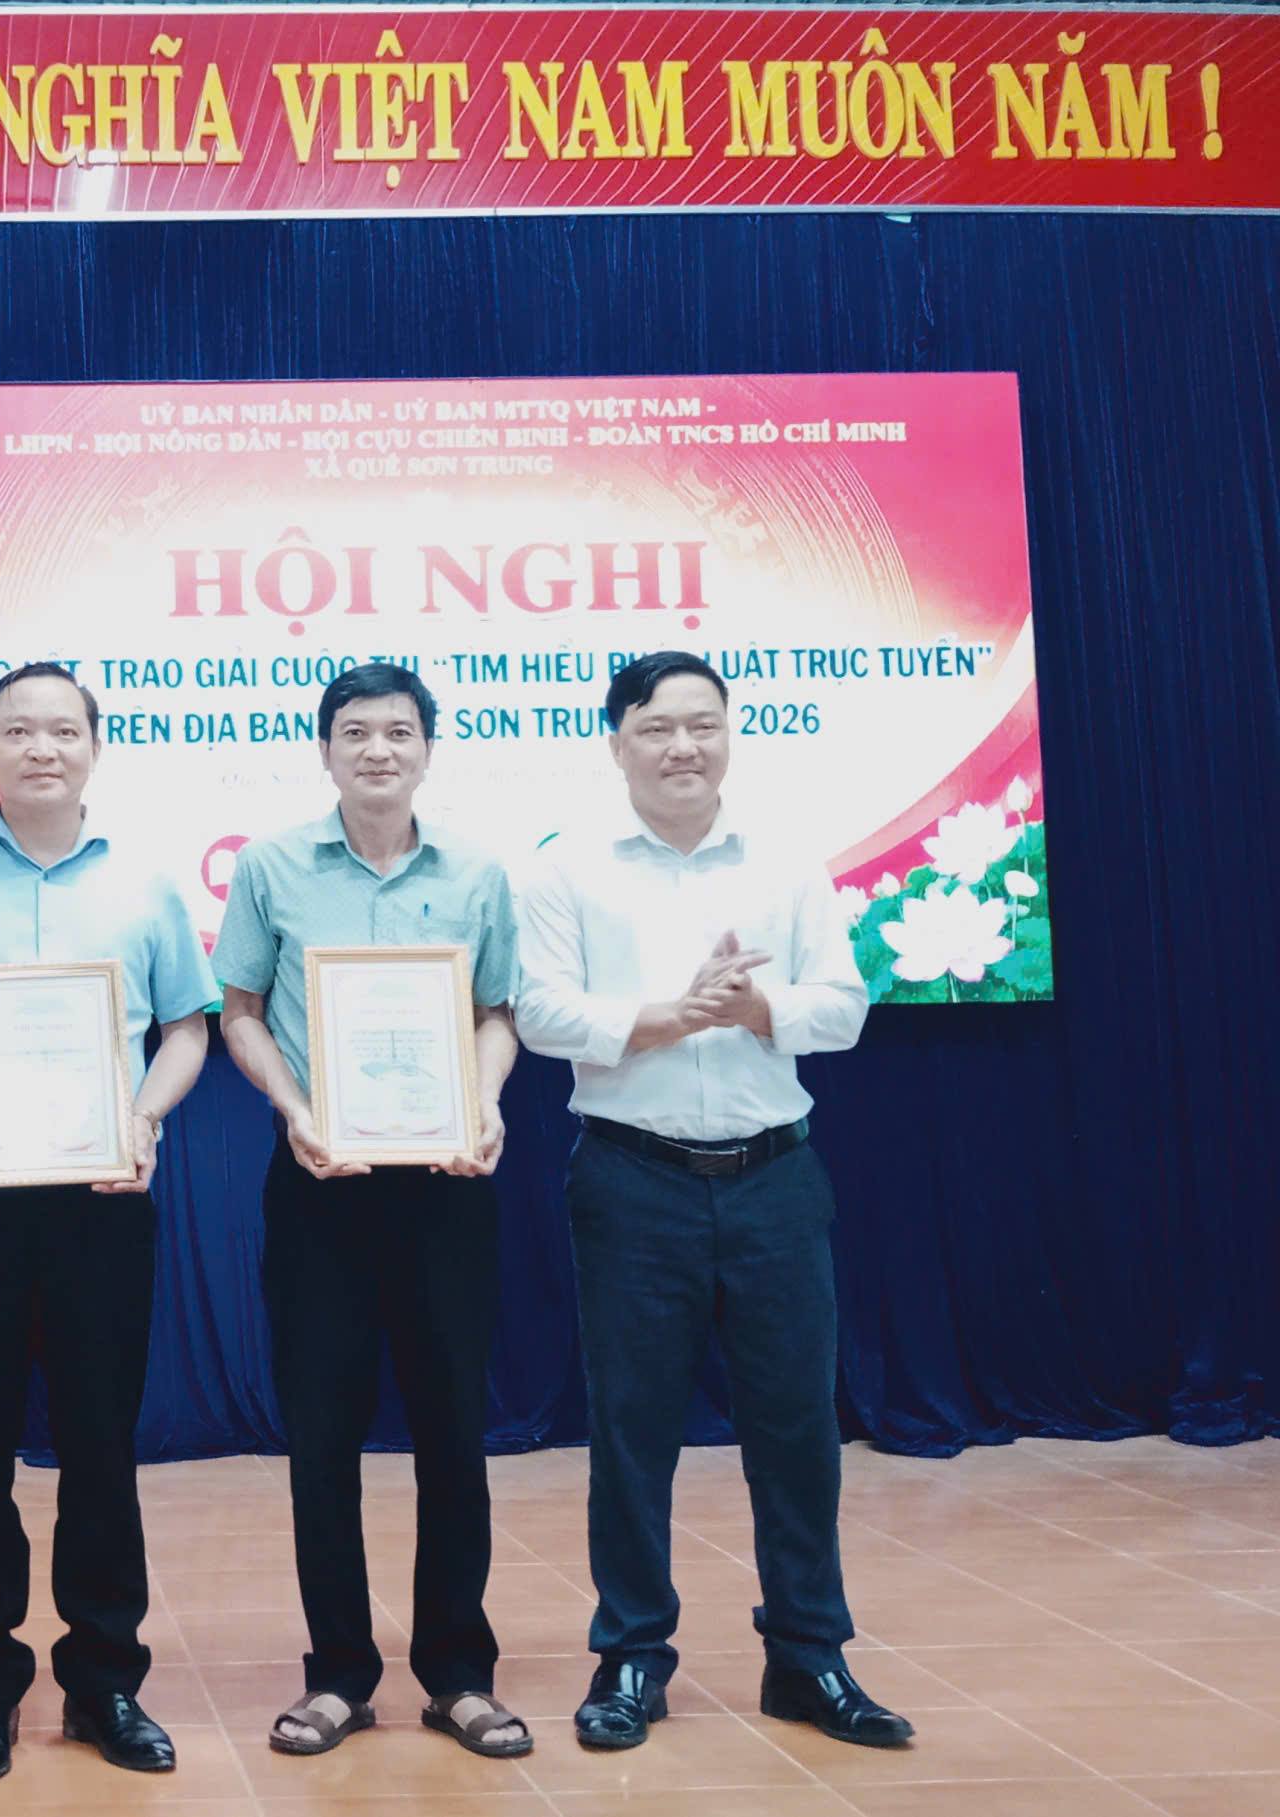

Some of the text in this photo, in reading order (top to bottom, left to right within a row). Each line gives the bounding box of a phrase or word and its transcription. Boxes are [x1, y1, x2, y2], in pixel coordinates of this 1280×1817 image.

[273, 30, 468, 189] VIỆT
[504, 60, 693, 160] NAM
[723, 28, 956, 159] MUÔN
[987, 31, 1176, 159] NĂM
[182, 403, 233, 425] BAN
[240, 398, 312, 424] NHÂN
[319, 398, 373, 423] DÂN
[435, 401, 486, 422] BAN
[494, 400, 569, 422] MTTQ
[574, 396, 637, 422] VIỆT
[641, 398, 701, 417] NAM
[5, 433, 72, 455] LHPN
[94, 432, 141, 456] HỘI
[148, 427, 222, 452] NÔNG
[228, 427, 280, 452] DÂN
[302, 430, 350, 453] HỘI
[588, 421, 661, 446] ĐOÀN
[667, 424, 734, 444] TNCS
[784, 418, 830, 442] CHÍ
[836, 422, 907, 442] MINH
[462, 455, 553, 477] TRUNG
[169, 526, 710, 637] HỘI NGHỊ
[99, 657, 184, 689] TRAO
[183, 712, 238, 751] ĐỊA
[455, 706, 521, 741] SƠN
[738, 703, 822, 737] 2026
